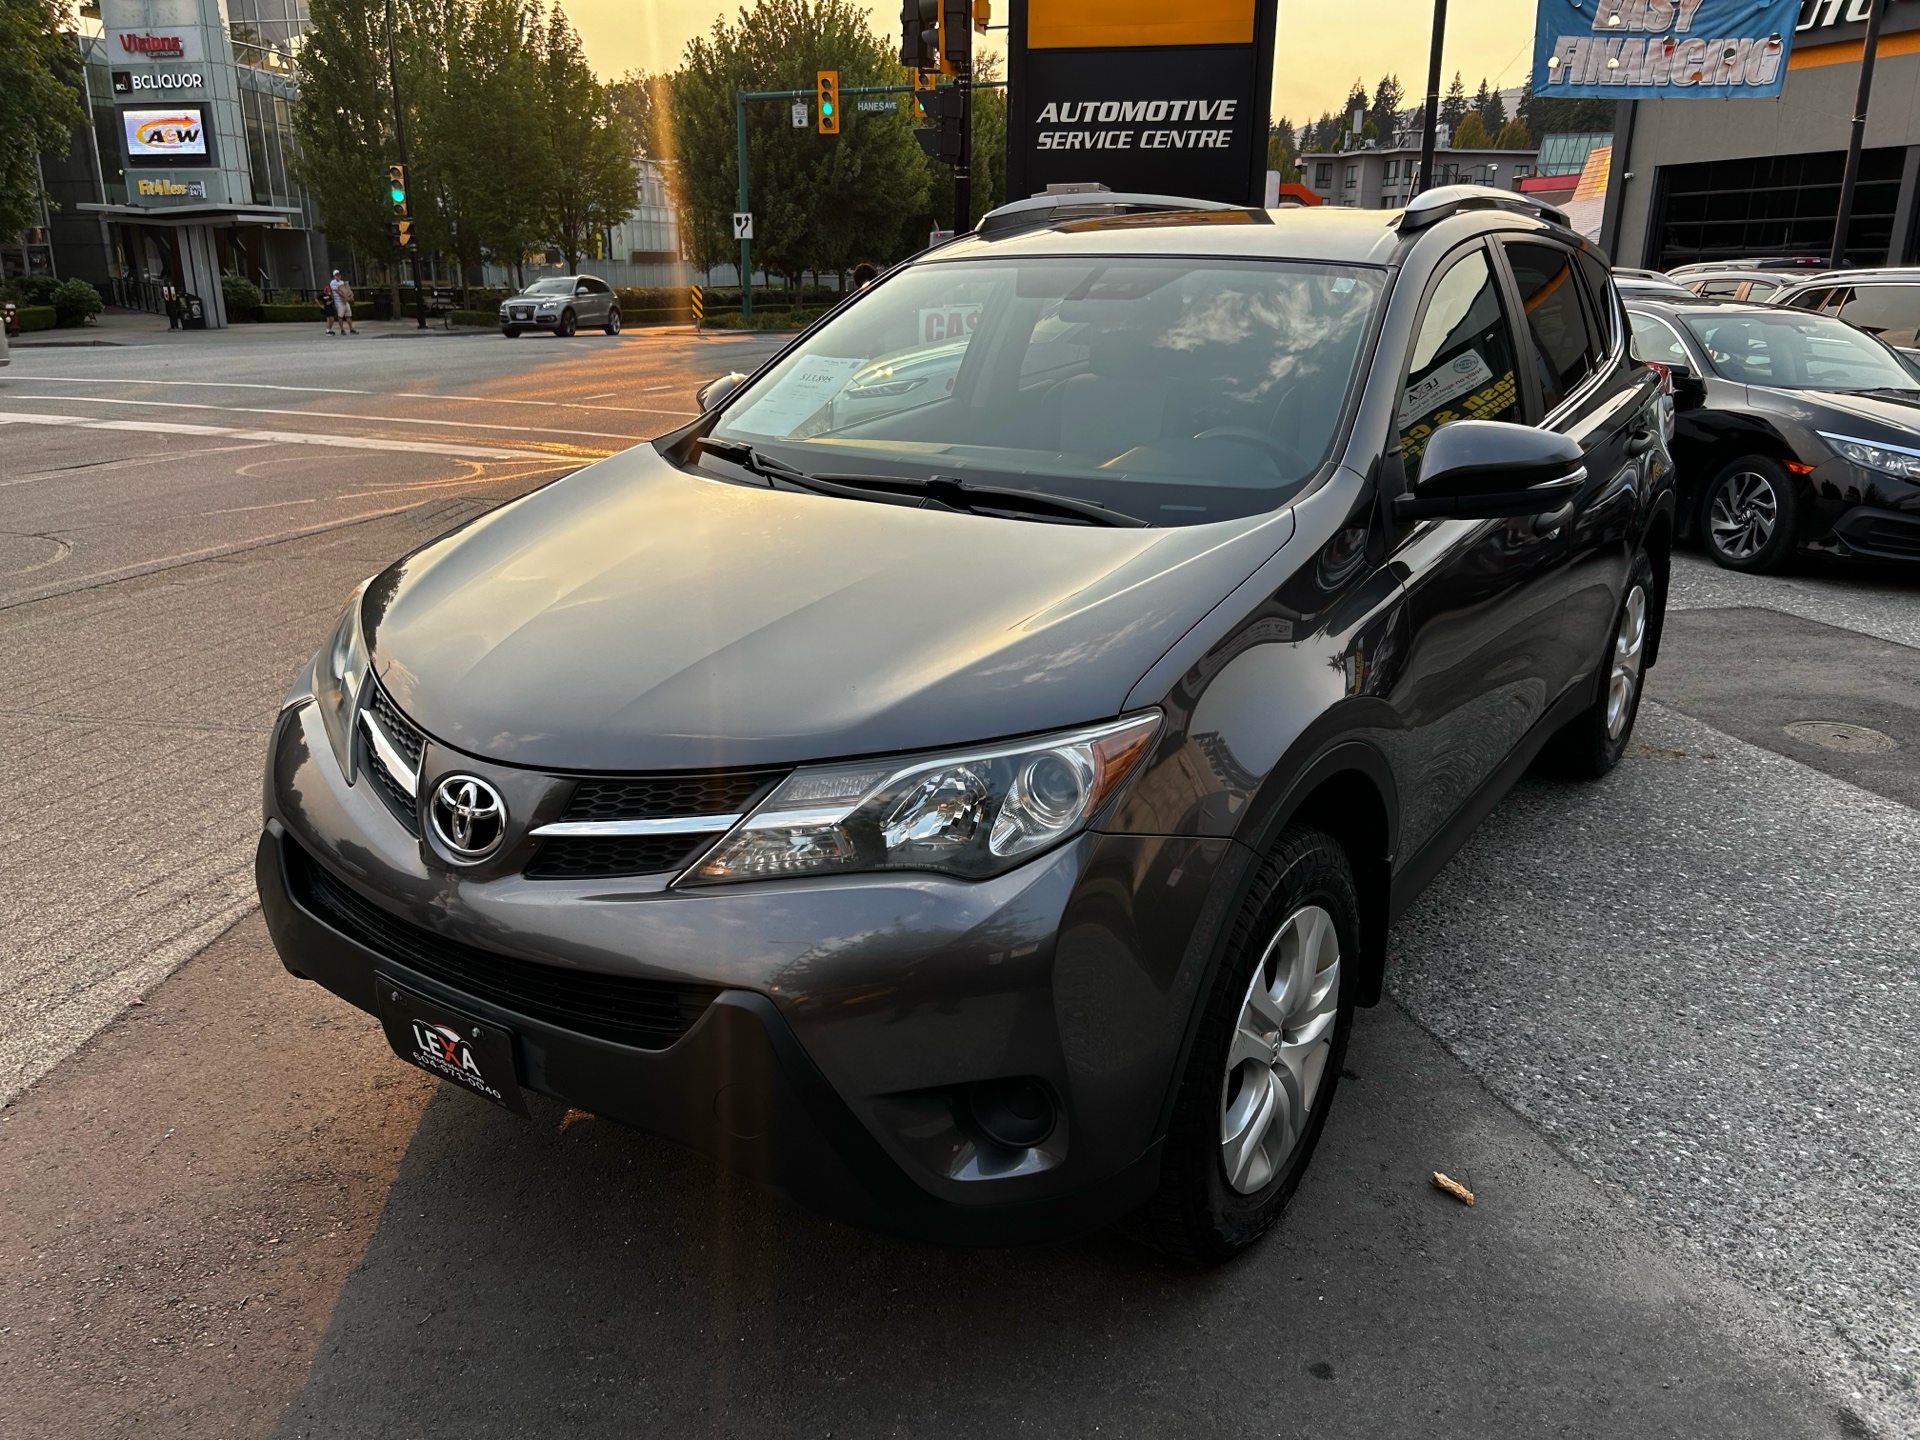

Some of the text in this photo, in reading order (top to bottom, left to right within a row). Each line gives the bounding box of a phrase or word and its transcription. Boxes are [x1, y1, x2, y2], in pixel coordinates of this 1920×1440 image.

[1592, 0, 1704, 32] EASY
[119, 33, 181, 52] Visions
[1548, 36, 1784, 86] FINANCING
[857, 102, 897, 111] HANES AVE
[1036, 100, 1238, 123] AUTOMOTIVE
[146, 127, 200, 145] A&W
[1036, 130, 1233, 149] SERVICE CENTRE
[412, 1024, 481, 1077] LEXA
[412, 1051, 502, 1099] 604-971-0040
